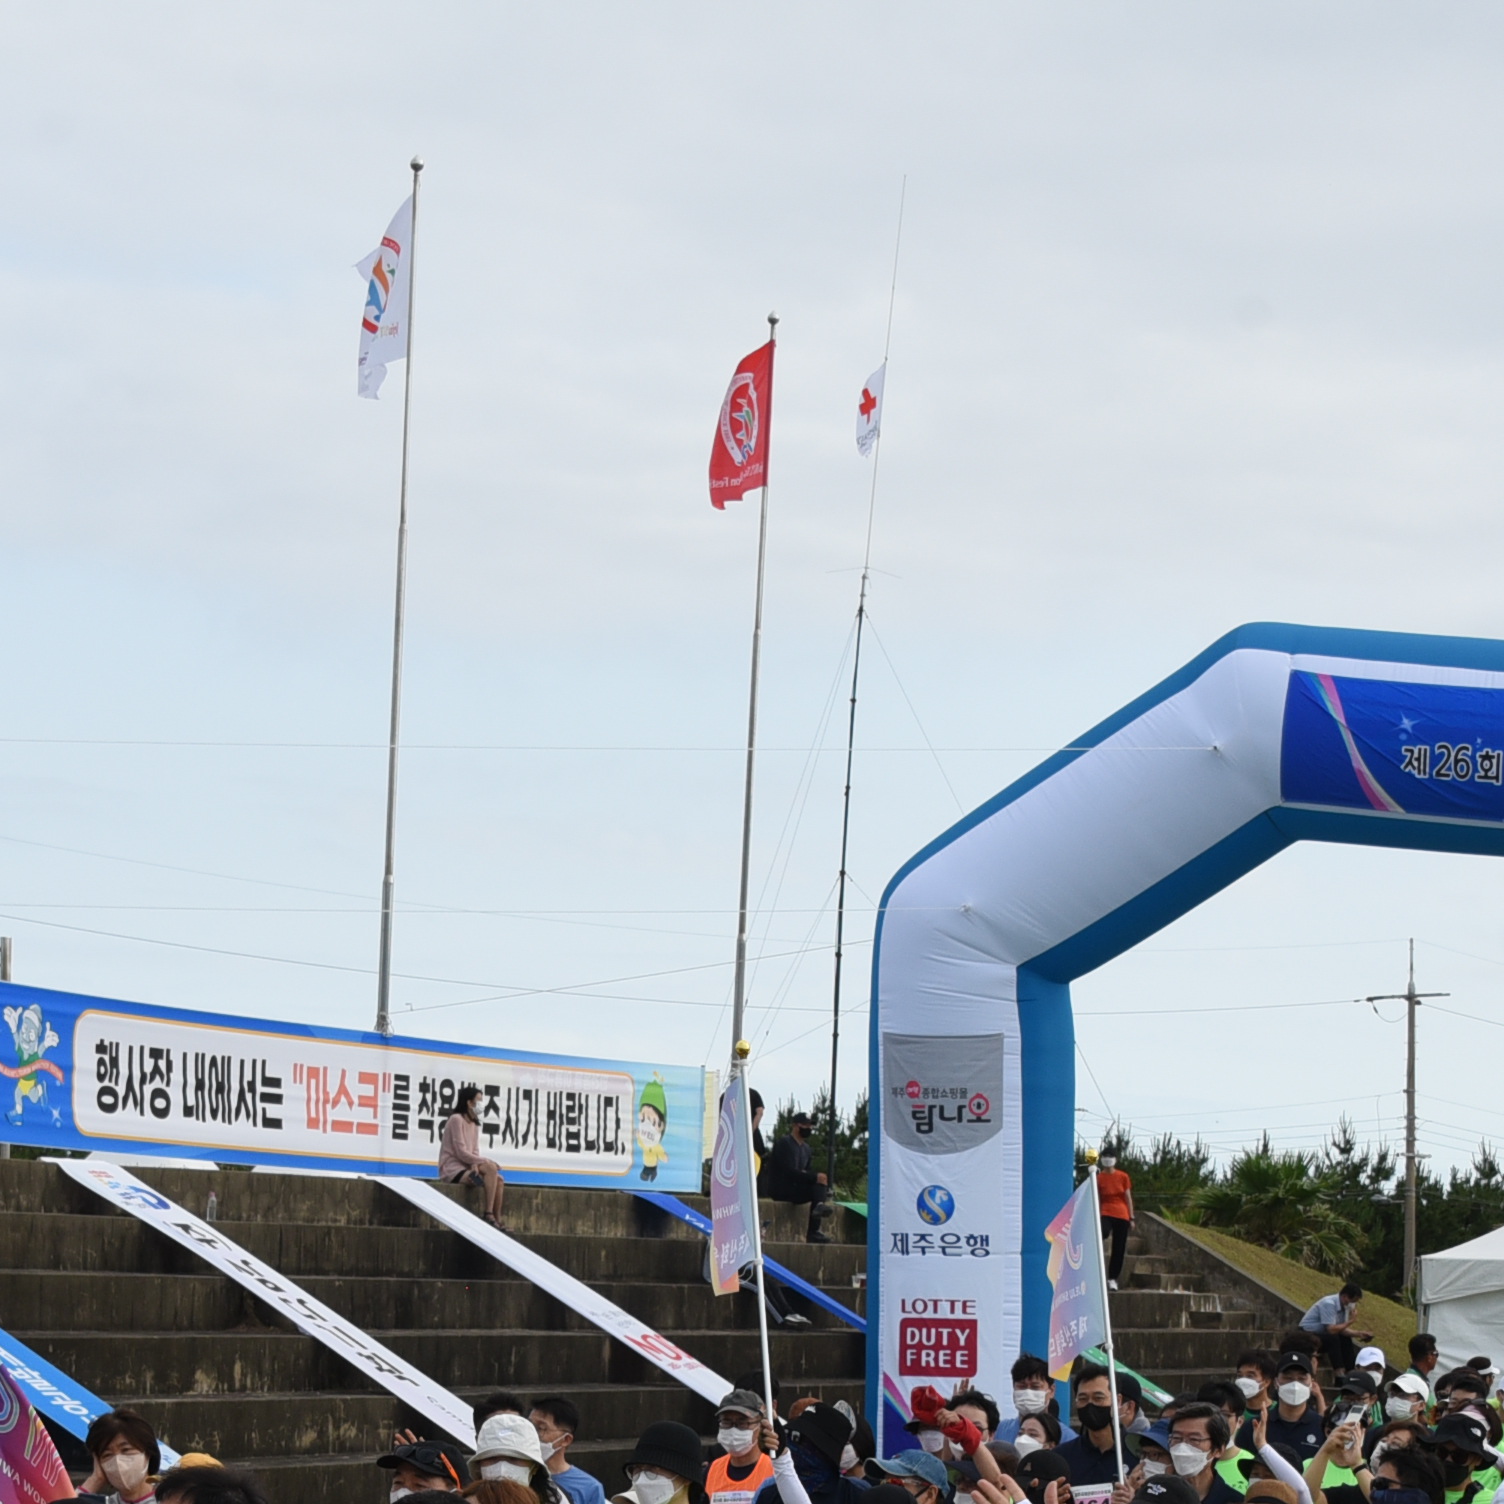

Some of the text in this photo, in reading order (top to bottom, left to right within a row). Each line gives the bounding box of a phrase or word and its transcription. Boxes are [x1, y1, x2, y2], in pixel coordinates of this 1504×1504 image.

[1401, 743, 1501, 784] 제26회
[95, 1038, 172, 1119] 행사장
[181, 1051, 283, 1131] 내에서는
[293, 1062, 411, 1142] "마스크"를
[417, 1076, 477, 1144] 착용
[542, 1091, 628, 1155] 바랍니다.
[911, 1093, 991, 1134] 탐나오
[890, 1232, 991, 1257] 제주은행
[901, 1298, 977, 1315] LOTTE
[906, 1327, 971, 1346] DUTY
[906, 1349, 969, 1369] FREE
